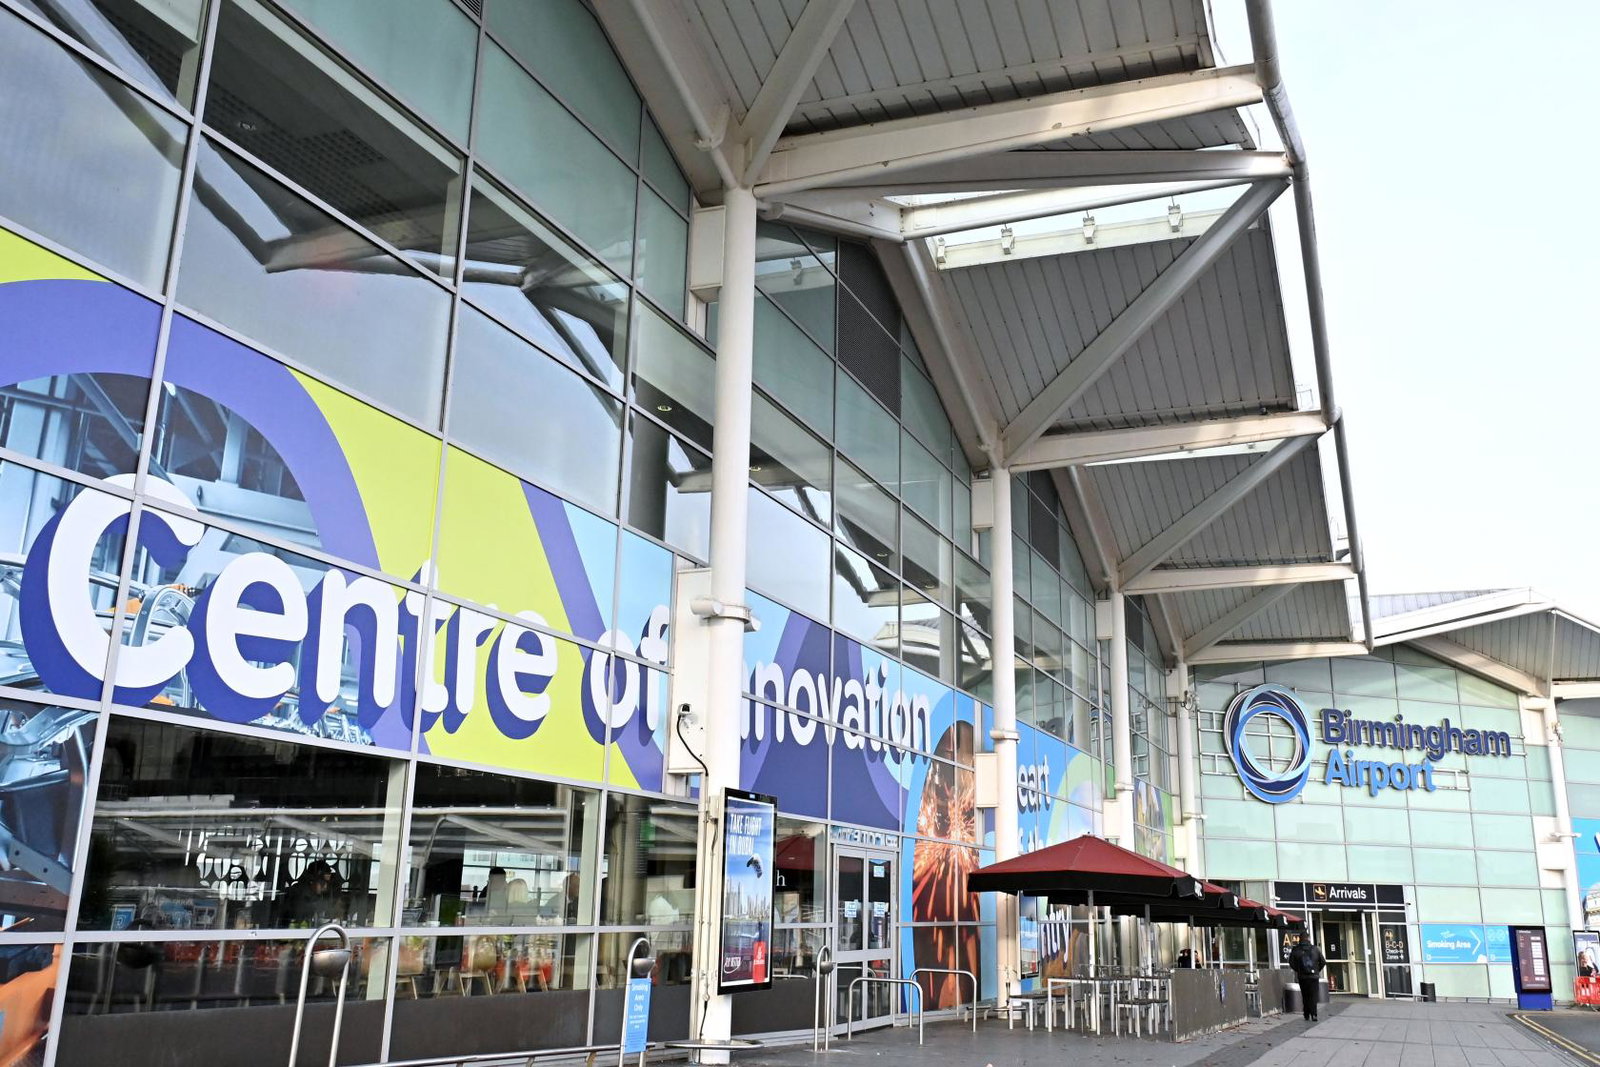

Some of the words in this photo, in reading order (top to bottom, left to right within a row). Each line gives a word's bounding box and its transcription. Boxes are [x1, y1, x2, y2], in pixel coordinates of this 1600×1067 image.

[47, 473, 558, 721] Centre
[590, 604, 670, 731] of
[740, 658, 932, 754] novation
[1320, 708, 1512, 762] Birmingham
[1018, 754, 1051, 807] eart
[1324, 748, 1437, 797] Airport
[730, 813, 744, 834] TAKE
[1329, 886, 1367, 899] Arrivals
[1283, 933, 1292, 947] A
[1427, 940, 1455, 950] Smoking
[1456, 940, 1471, 948] Area
